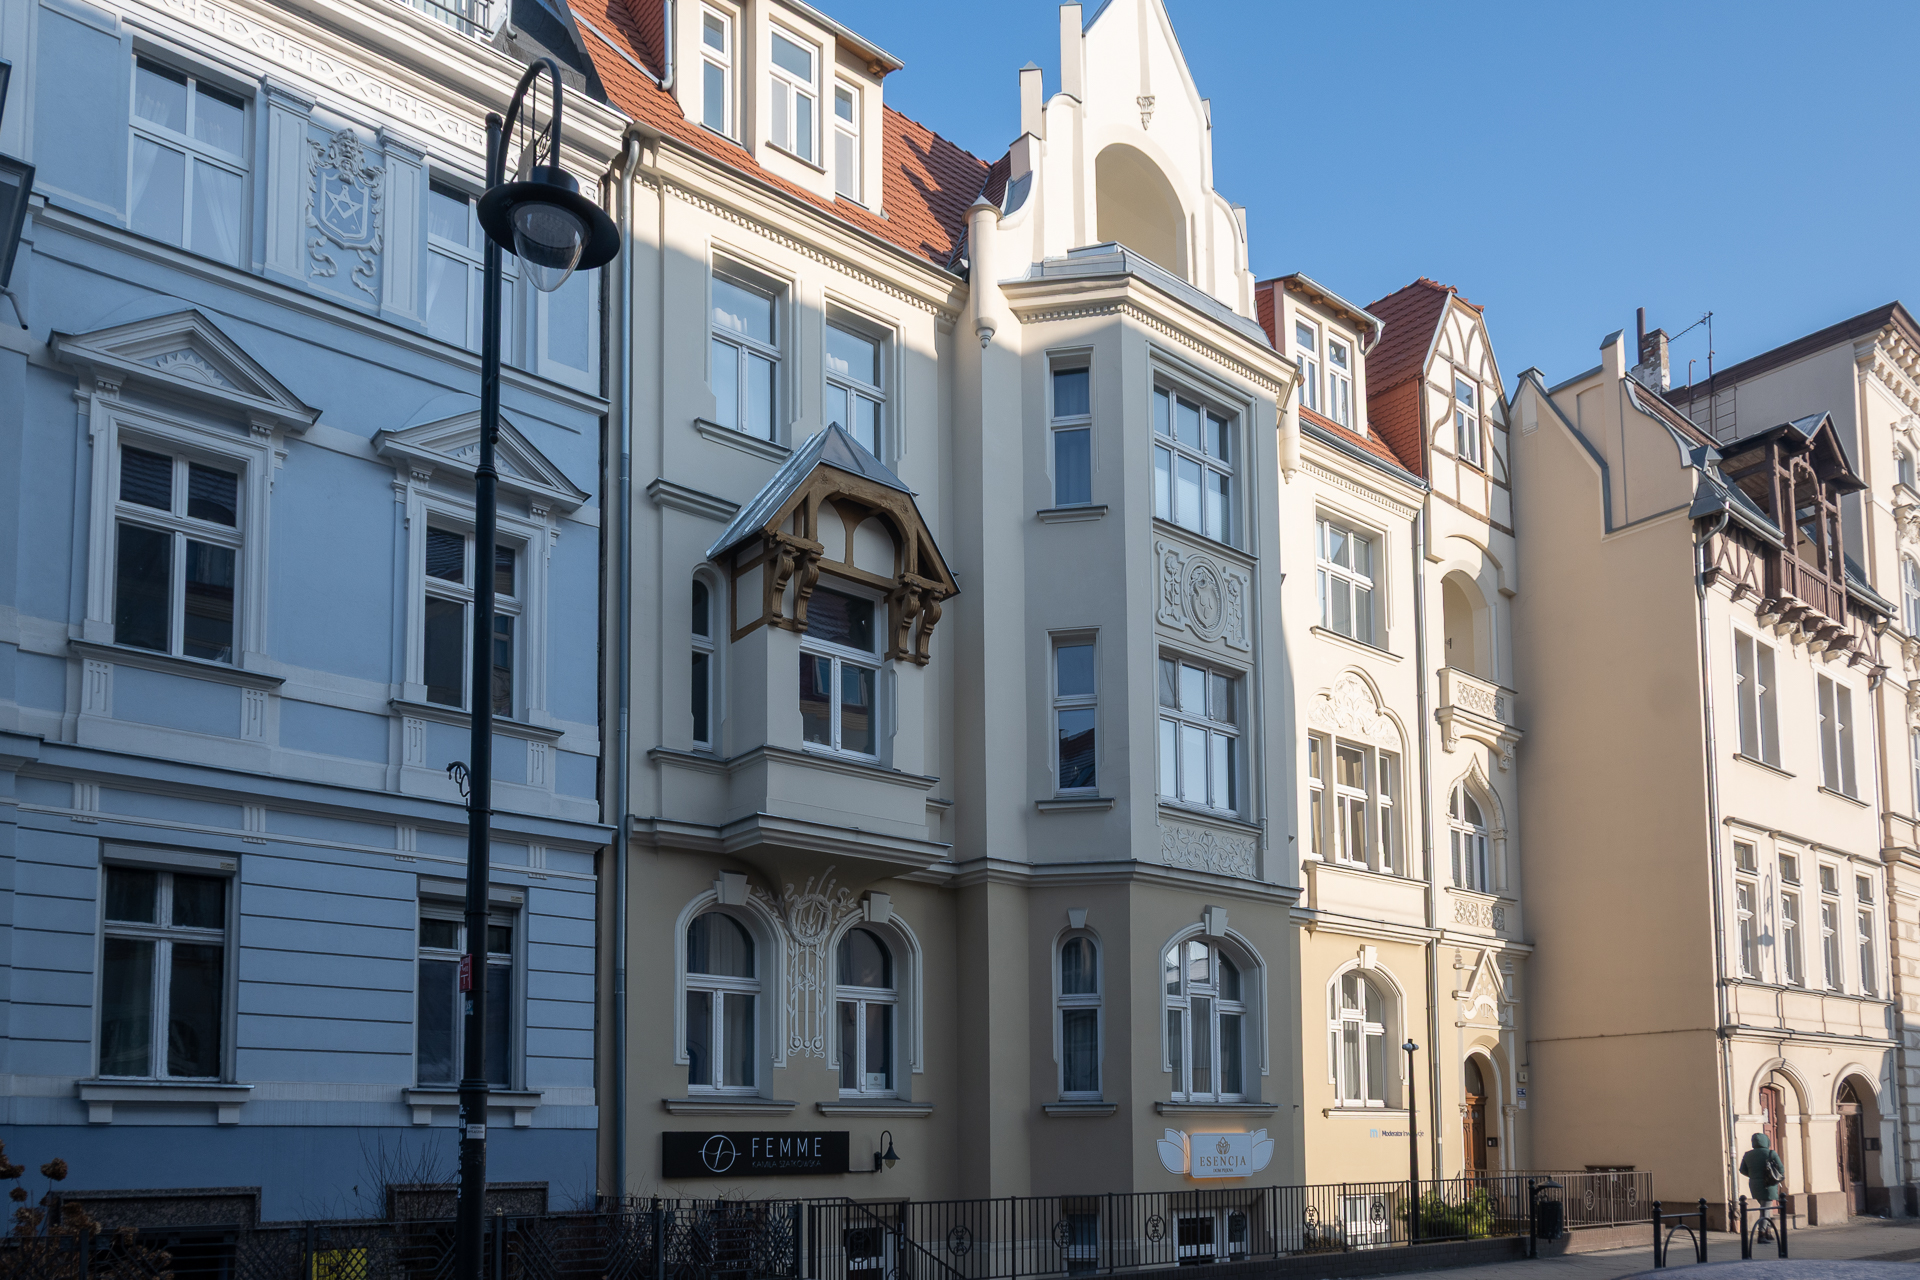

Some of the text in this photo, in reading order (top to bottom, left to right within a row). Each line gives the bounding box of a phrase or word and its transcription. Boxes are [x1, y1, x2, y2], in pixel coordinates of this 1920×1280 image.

[1381, 1129, 1403, 1137] Moderator
[751, 1137, 822, 1158] FEMME
[752, 1159, 822, 1169] KAMILA SZATKOWSKA
[1199, 1155, 1247, 1168] ESENCJA
